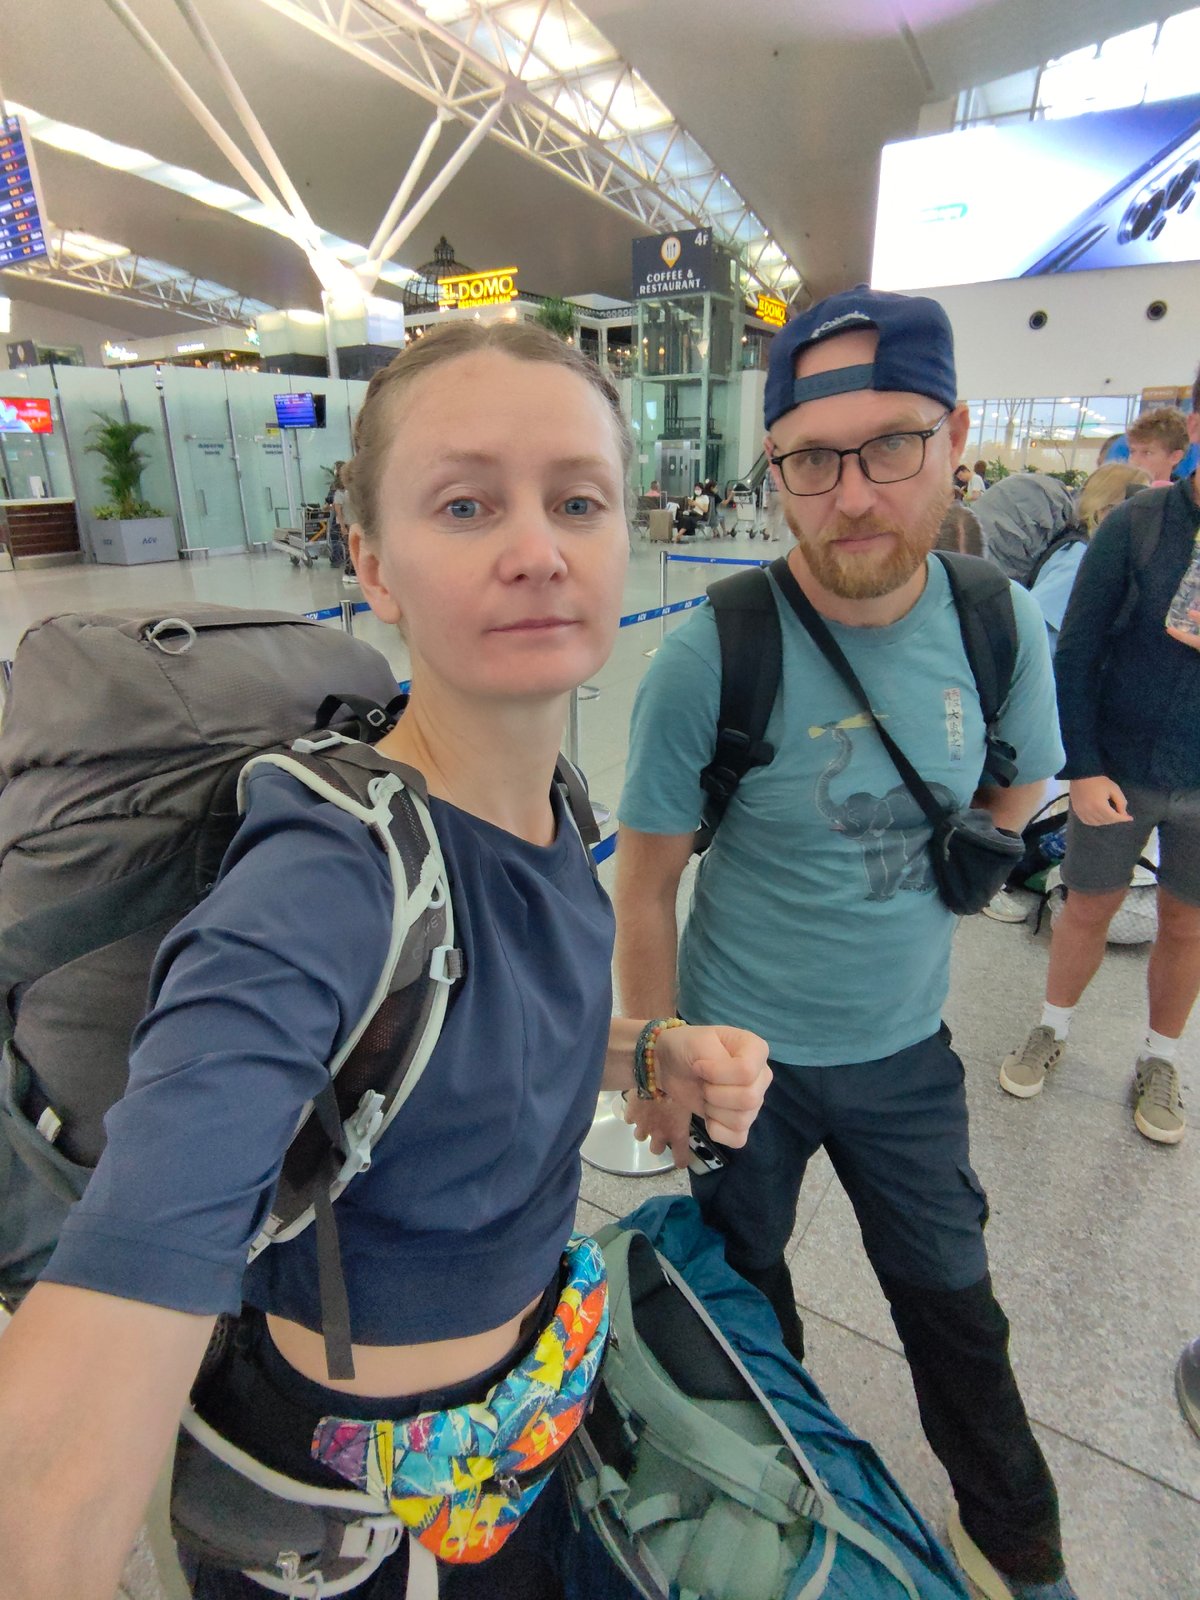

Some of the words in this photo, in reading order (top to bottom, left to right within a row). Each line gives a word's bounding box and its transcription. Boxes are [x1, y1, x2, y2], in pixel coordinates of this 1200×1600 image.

[694, 232, 709, 246] 4F
[646, 270, 683, 283] COFFEE
[687, 269, 694, 279] &
[458, 275, 513, 300] DOMO
[640, 278, 701, 295] RESTAURANT
[764, 301, 786, 321] DOMO
